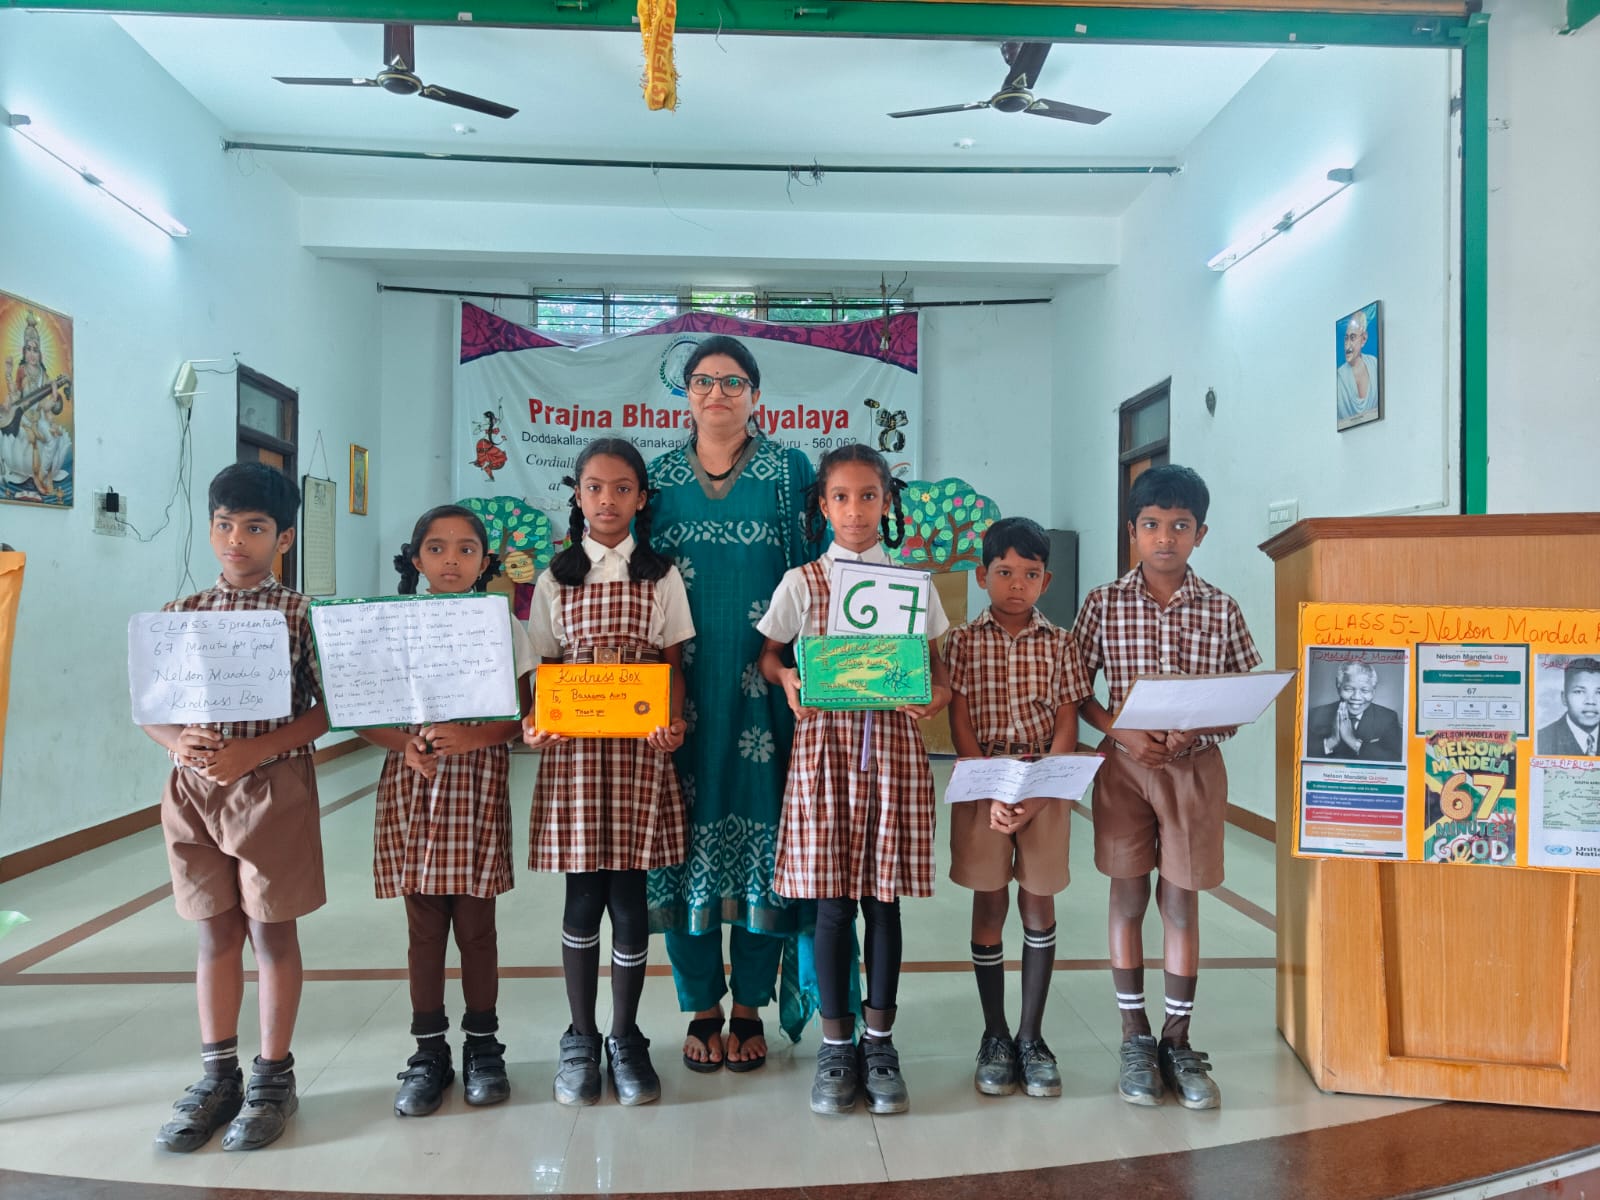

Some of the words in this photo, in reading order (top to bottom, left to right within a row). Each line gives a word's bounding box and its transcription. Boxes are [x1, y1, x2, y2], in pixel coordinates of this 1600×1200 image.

[528, 398, 612, 431] Prajna
[622, 403, 692, 428] Bhara
[752, 404, 849, 434] dyalaya
[812, 438, 832, 448] 560
[526, 454, 577, 468] Cordiall
[548, 481, 561, 491] at
[843, 580, 926, 634] 67
[149, 619, 209, 633] CLASS
[1314, 613, 1385, 631] CLASS
[1421, 611, 1494, 643] Nelson
[1503, 615, 1588, 645] Mandela
[1314, 633, 1374, 645] Celebrates
[154, 641, 174, 656] 67
[152, 665, 204, 682] Nelson
[559, 668, 614, 683] Kindness
[1467, 687, 1477, 695] 67
[1437, 731, 1463, 739] NELSON
[1465, 731, 1493, 739] MANDELA
[1494, 731, 1508, 739] DAY
[1433, 740, 1502, 758] NELSON
[1432, 756, 1509, 775] MANDELA
[1440, 772, 1506, 820] 67
[1435, 821, 1508, 838] MINUTES
[1434, 838, 1509, 861] GOOD
